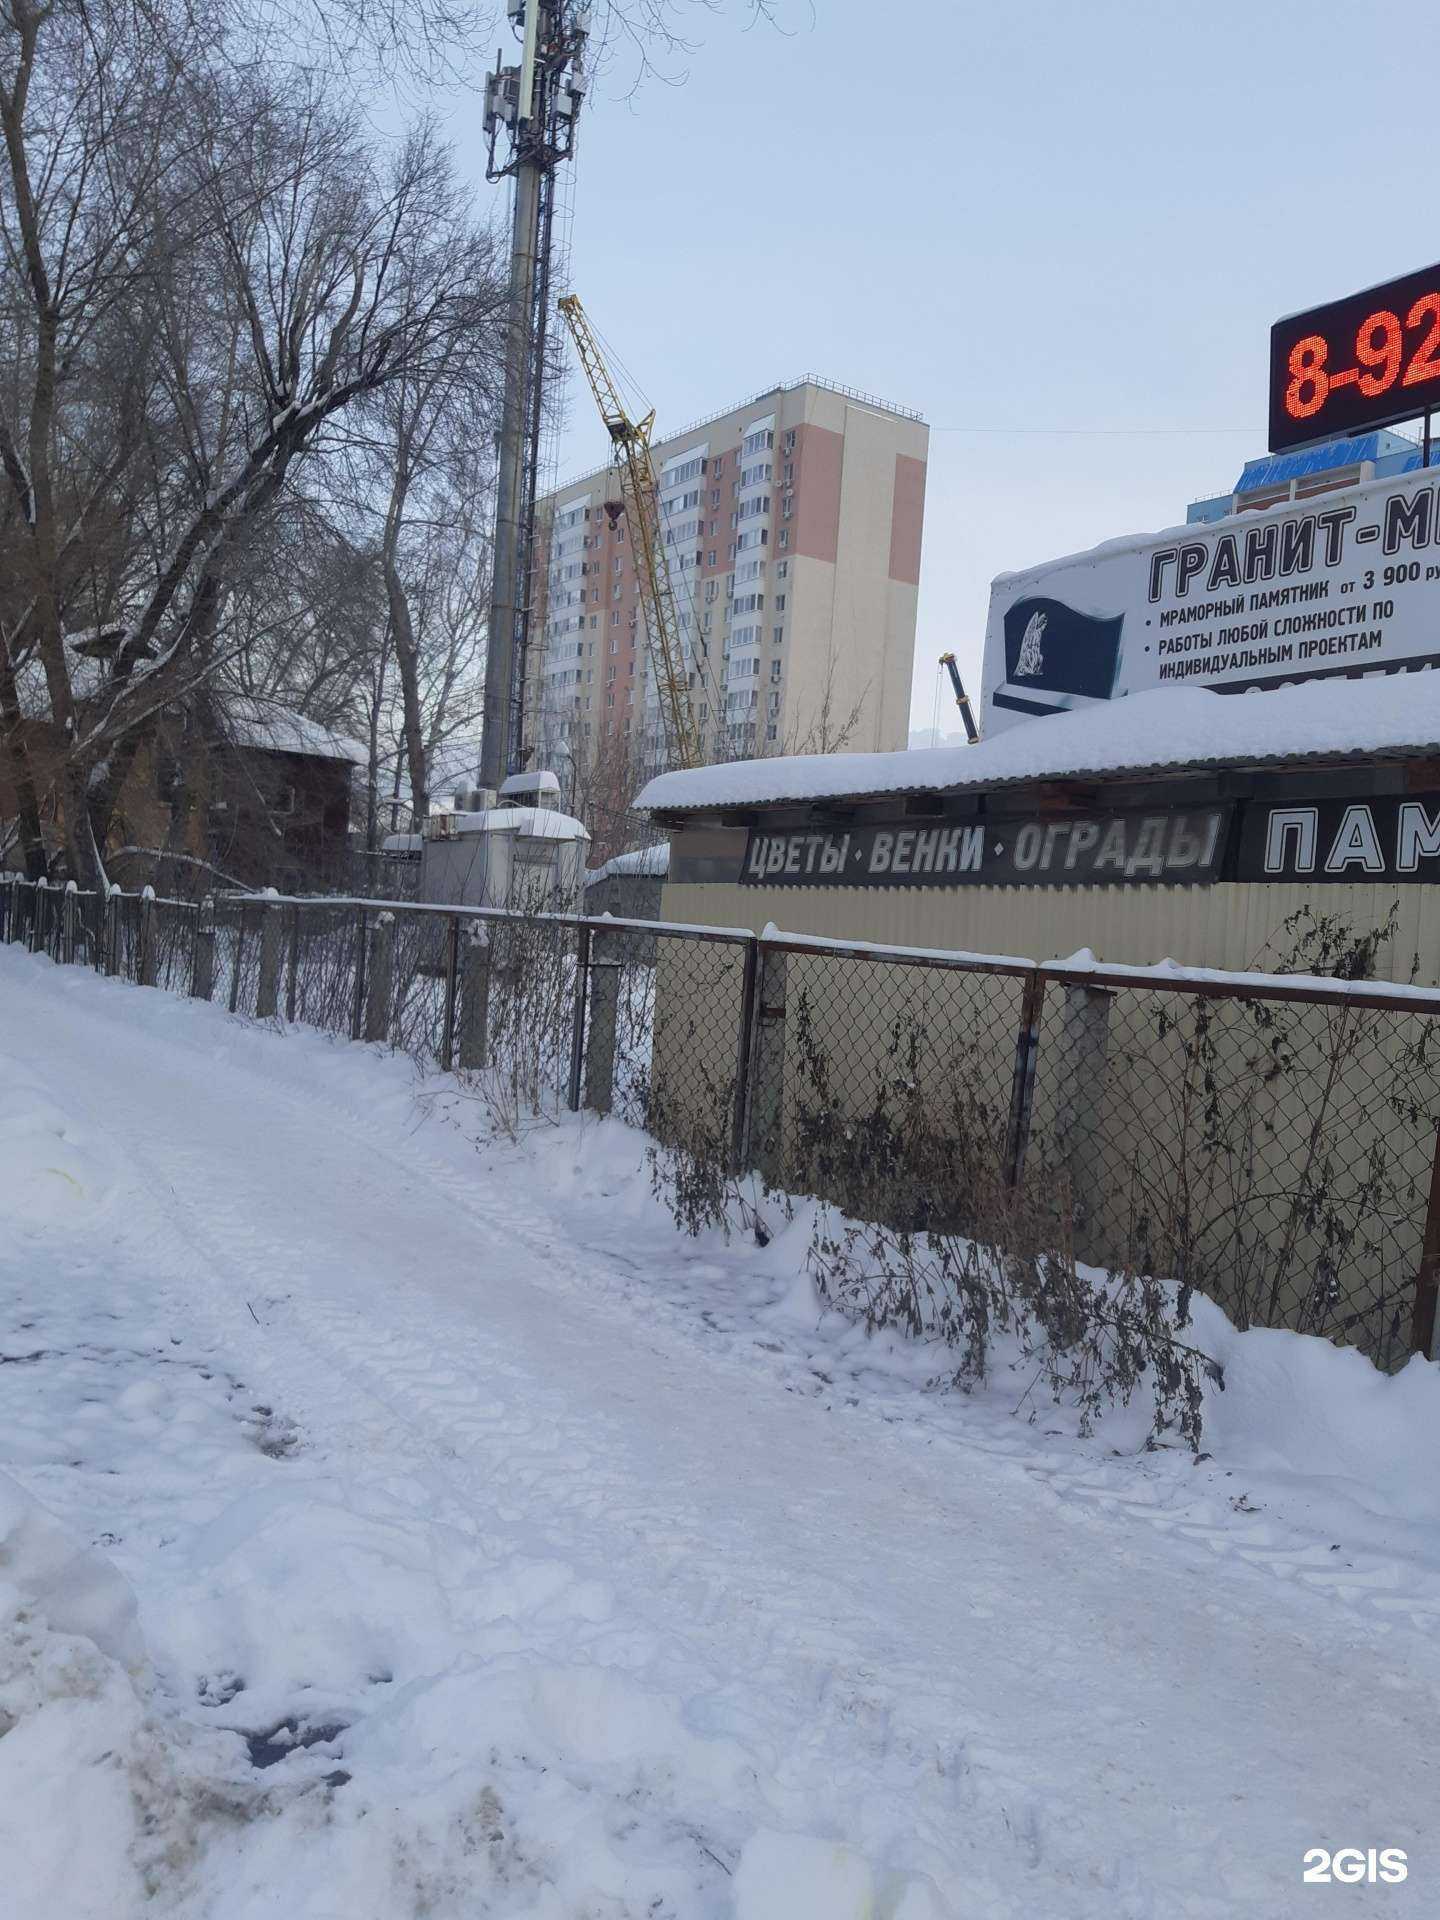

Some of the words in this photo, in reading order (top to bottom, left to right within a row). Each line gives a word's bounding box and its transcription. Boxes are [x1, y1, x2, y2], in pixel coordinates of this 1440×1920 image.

[1286, 292, 1440, 418] 8-92
[1148, 487, 1440, 603] ГРАНИТ-М
[1159, 631, 1213, 656] РАБОТЫ
[1217, 619, 1269, 646] ЛЮБОЙ
[1274, 604, 1367, 637] СЛОЖНОСТИ
[1373, 600, 1394, 620] ПО
[1160, 594, 1245, 628] МРАМОРНЫЙ
[1250, 580, 1329, 611] ПАМЯТНИК
[1341, 582, 1355, 594] от
[1363, 570, 1375, 590] 3
[1383, 561, 1421, 586] 900
[1159, 643, 1293, 680] ИНДИВИДУАЛЬНЫМ
[1298, 629, 1382, 659] ПРОЕКТАМ
[749, 833, 850, 879] ЦВЕТЫ
[868, 825, 985, 873] ВЕНКИ
[1014, 813, 1222, 877] ОГРАДЫ
[1264, 802, 1440, 873] ПАМ
